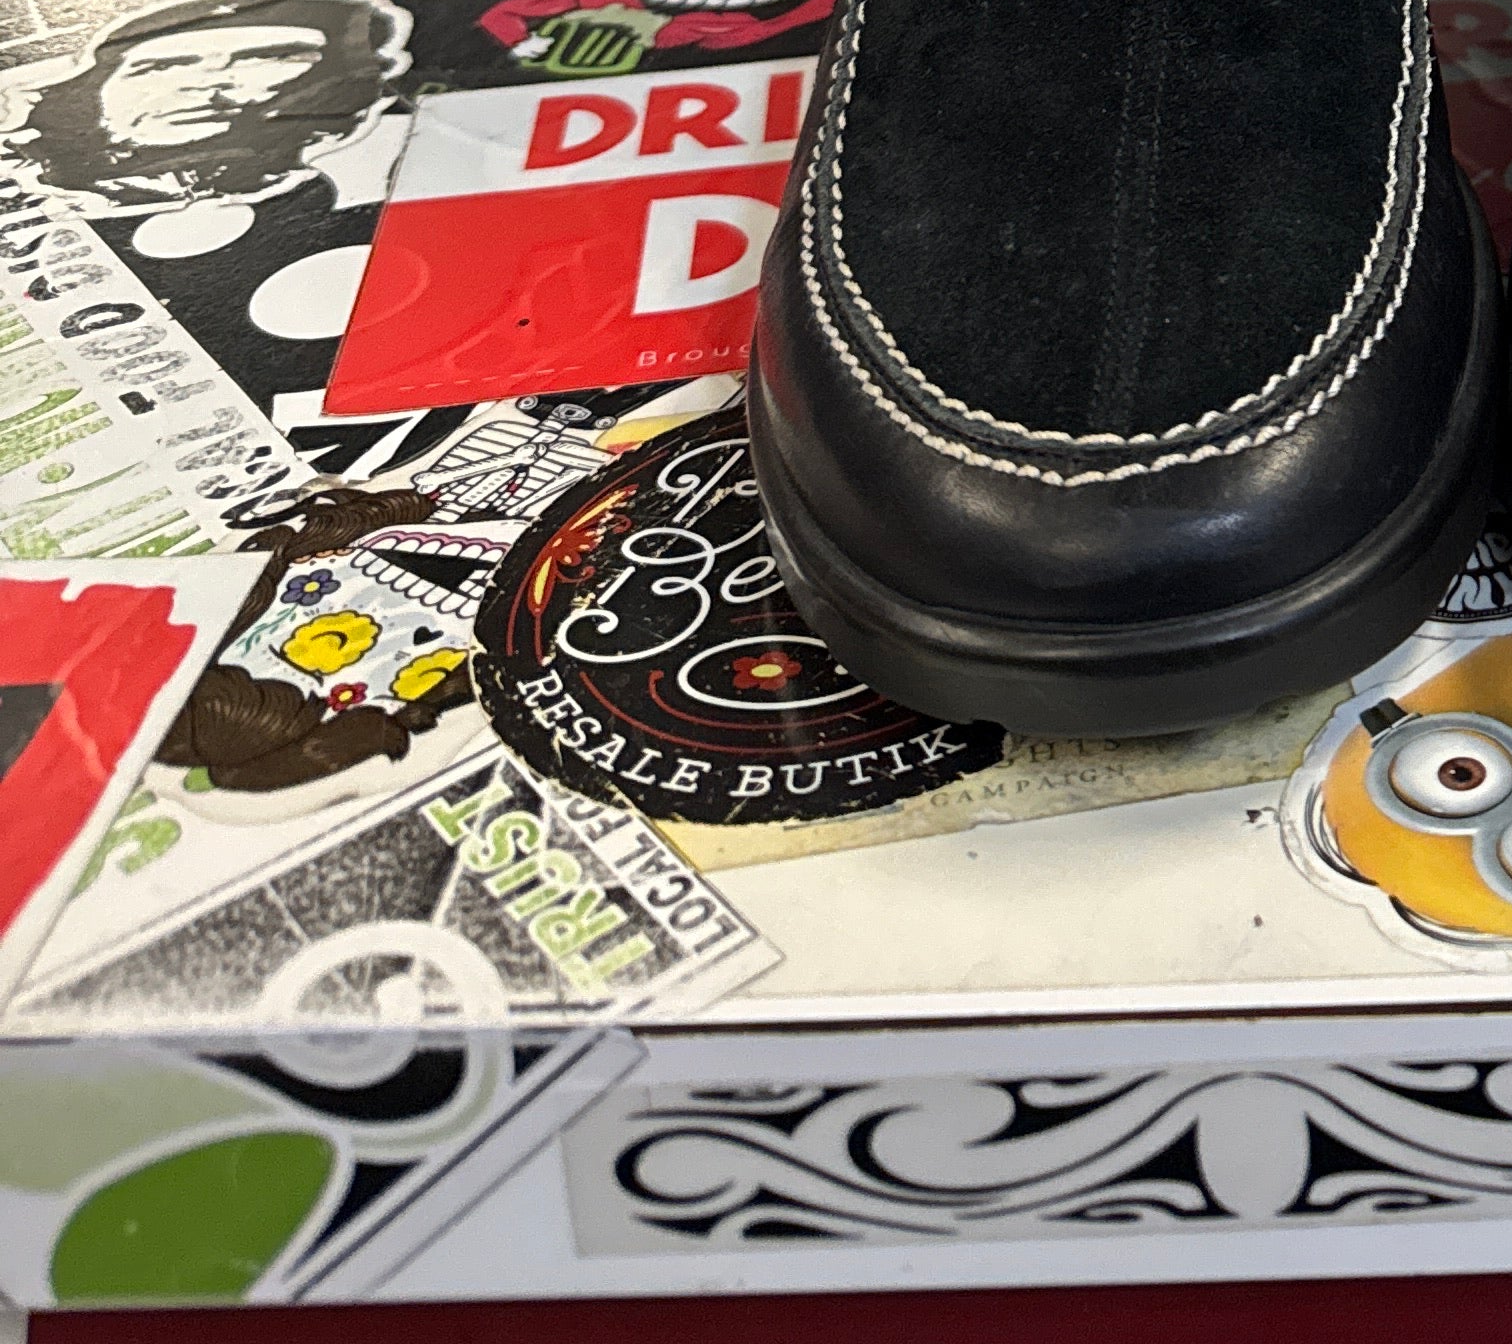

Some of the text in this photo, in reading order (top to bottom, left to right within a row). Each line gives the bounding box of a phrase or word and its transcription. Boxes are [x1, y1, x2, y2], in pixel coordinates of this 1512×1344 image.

[523, 70, 804, 171] DRI
[59, 303, 216, 416] FOOD
[162, 406, 306, 530] OCAL
[515, 668, 967, 798] RESALE BUTIK
[930, 766, 1125, 808] CAMPAIGN
[419, 779, 656, 1001] TRUST
[615, 831, 739, 955] LOCAL
